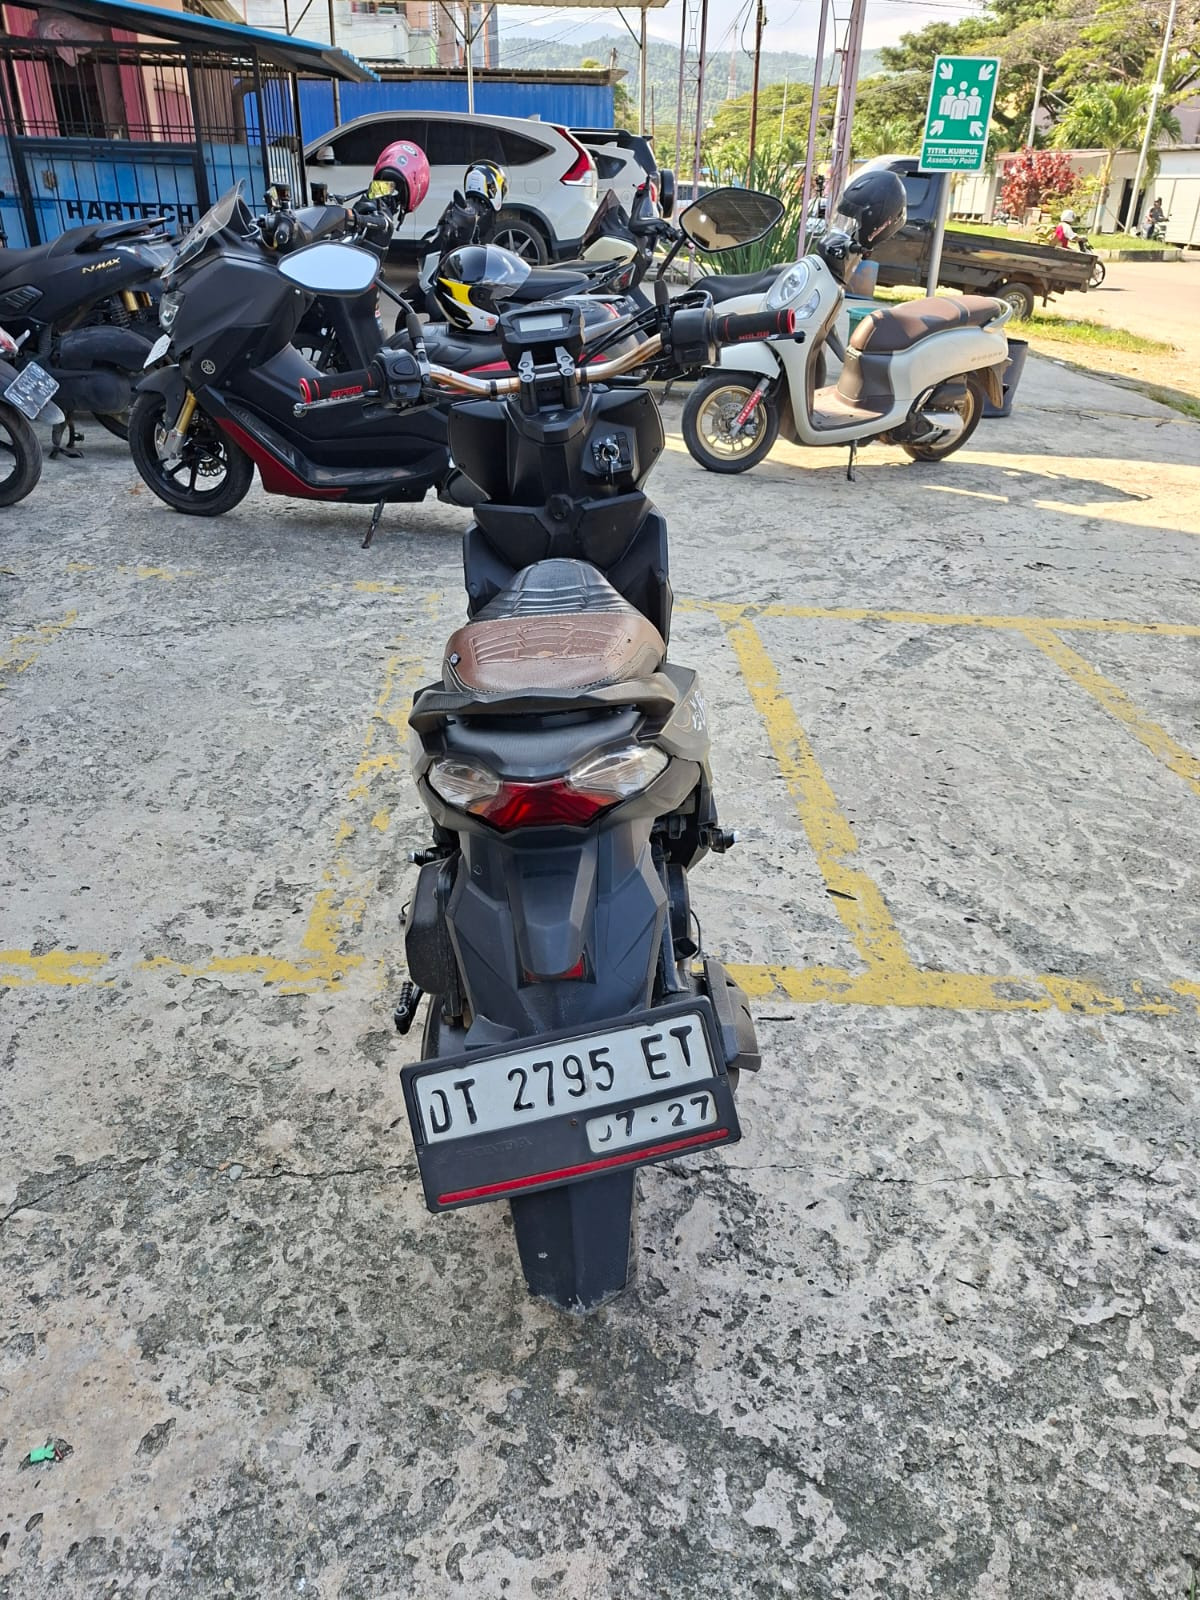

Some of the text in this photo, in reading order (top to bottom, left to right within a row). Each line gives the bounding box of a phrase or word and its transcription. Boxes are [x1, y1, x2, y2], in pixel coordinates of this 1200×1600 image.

[926, 147, 978, 156] TITIK KUMPUL
[926, 156, 958, 165] Assembly
[66, 200, 194, 223] HARTECH
[428, 1025, 693, 1134] DT 2795 ET
